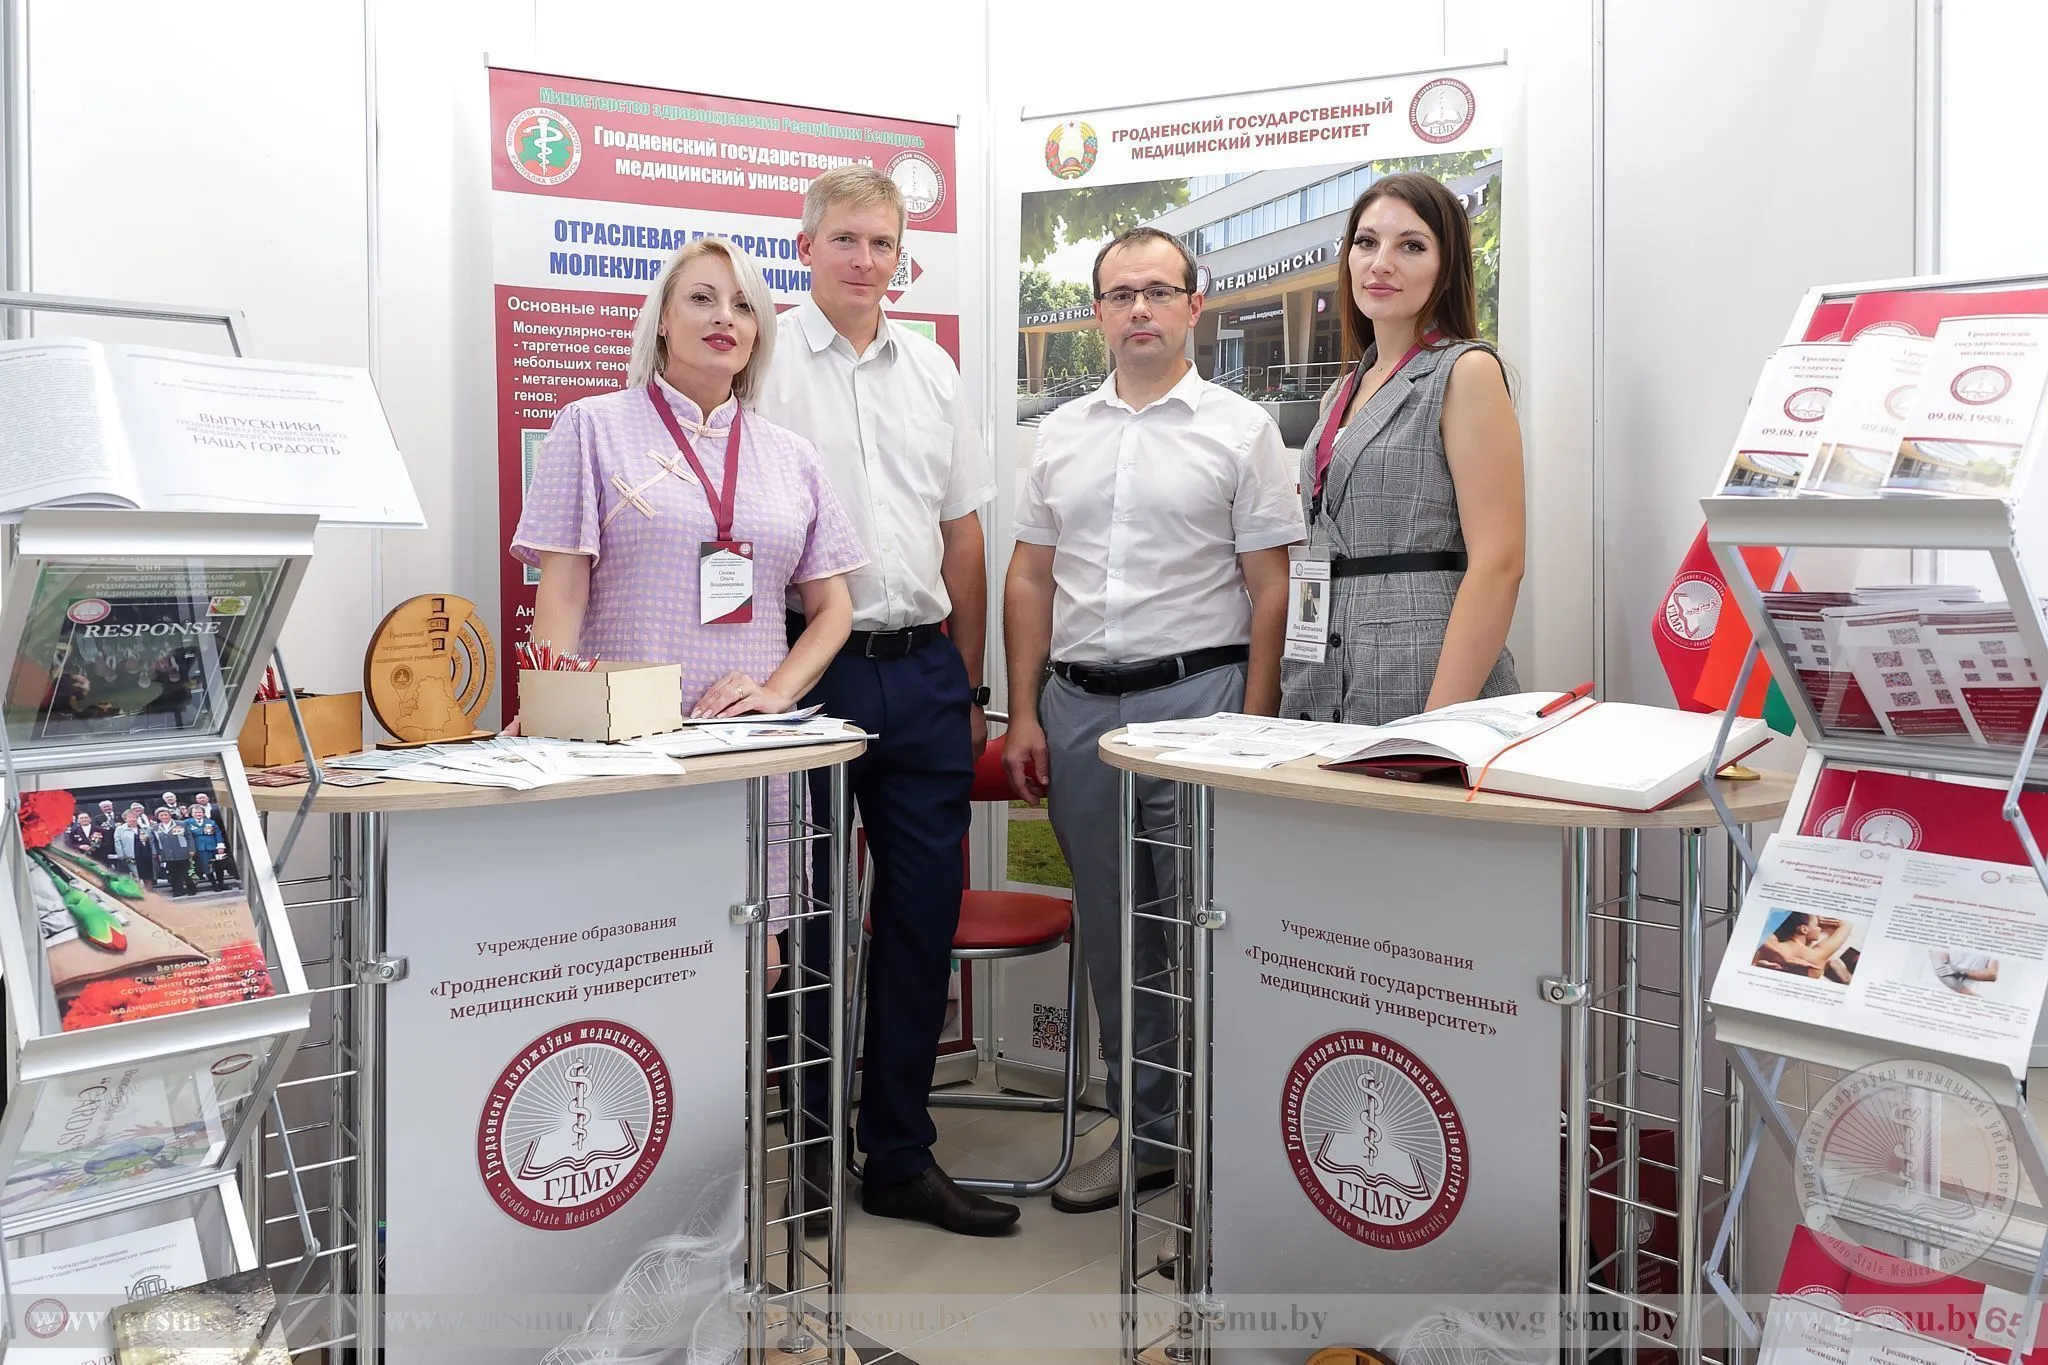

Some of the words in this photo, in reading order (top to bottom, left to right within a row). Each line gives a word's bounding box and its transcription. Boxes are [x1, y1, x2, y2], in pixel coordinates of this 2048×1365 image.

[540, 87, 650, 116] Министерство
[652, 103, 780, 132] здравоохранения
[782, 117, 862, 140] Республики
[864, 127, 925, 148] Беларусь
[1111, 115, 1224, 143] ГРОДНЕНСКИЙ
[1228, 96, 1394, 132] ГОСУДАРСТВЕННЫЙ
[593, 125, 718, 158] Гродненский
[1130, 132, 1252, 160] МЕДИЦИНСКИЙ
[1254, 122, 1370, 150] УНИВЕРСИТЕТ
[615, 158, 745, 187] медицинский
[554, 219, 686, 250] ОТРАСЛЕВАЯ
[549, 251, 667, 281] МОЛЕКУЛЯ
[1215, 247, 1323, 292] МЕДЫЦЫНСКІ
[507, 296, 596, 315] Основные
[513, 356, 592, 370] небольших
[521, 341, 590, 354] таргетное
[514, 391, 558, 404] генов;
[522, 374, 622, 390] метагеномика,
[199, 413, 322, 432] ВЫПУСКНИКИ
[1927, 412, 2002, 425] 09.08.1958
[192, 434, 248, 450] НАША
[250, 441, 341, 456] ГОРДОСТЬ
[84, 621, 222, 639] RESPONSE
[476, 930, 578, 956] Учреждение
[581, 915, 677, 942] образования
[1281, 919, 1370, 950] Учреждение
[1373, 938, 1475, 971] образования
[134, 966, 214, 984] Отечественной
[156, 959, 208, 973] Ветераны
[429, 964, 563, 999] «Гродненский
[567, 940, 715, 978] государственный
[1244, 945, 1356, 981] «Гродненский
[1359, 969, 1519, 1017] государственный
[449, 985, 578, 1020] медицинский
[583, 968, 697, 1001] университет»
[1260, 972, 1371, 1009] медицинский
[1374, 997, 1498, 1037] университет»
[484, 1093, 507, 1181] Гродзенскі
[503, 1030, 573, 1091] дзяржаўны
[579, 1027, 654, 1063] медыцынскі
[645, 1060, 671, 1143] ўніверсітэт
[1287, 1070, 1306, 1152] Гродзенскі
[1303, 1035, 1365, 1075] дзяржаўны
[1371, 1039, 1447, 1107] медыцынскі
[1438, 1111, 1465, 1203] ўніверсітэт
[499, 1187, 530, 1219] Grodno
[532, 1208, 560, 1225] State
[564, 1202, 606, 1225] Medical
[606, 1157, 655, 1207] University
[542, 1163, 622, 1205] ГДМУ
[1336, 1178, 1413, 1221] ГДМУ
[1299, 1166, 1325, 1207] Grodno
[1326, 1203, 1353, 1232] State
[1356, 1222, 1396, 1245] Medical
[1399, 1208, 1449, 1245] University
